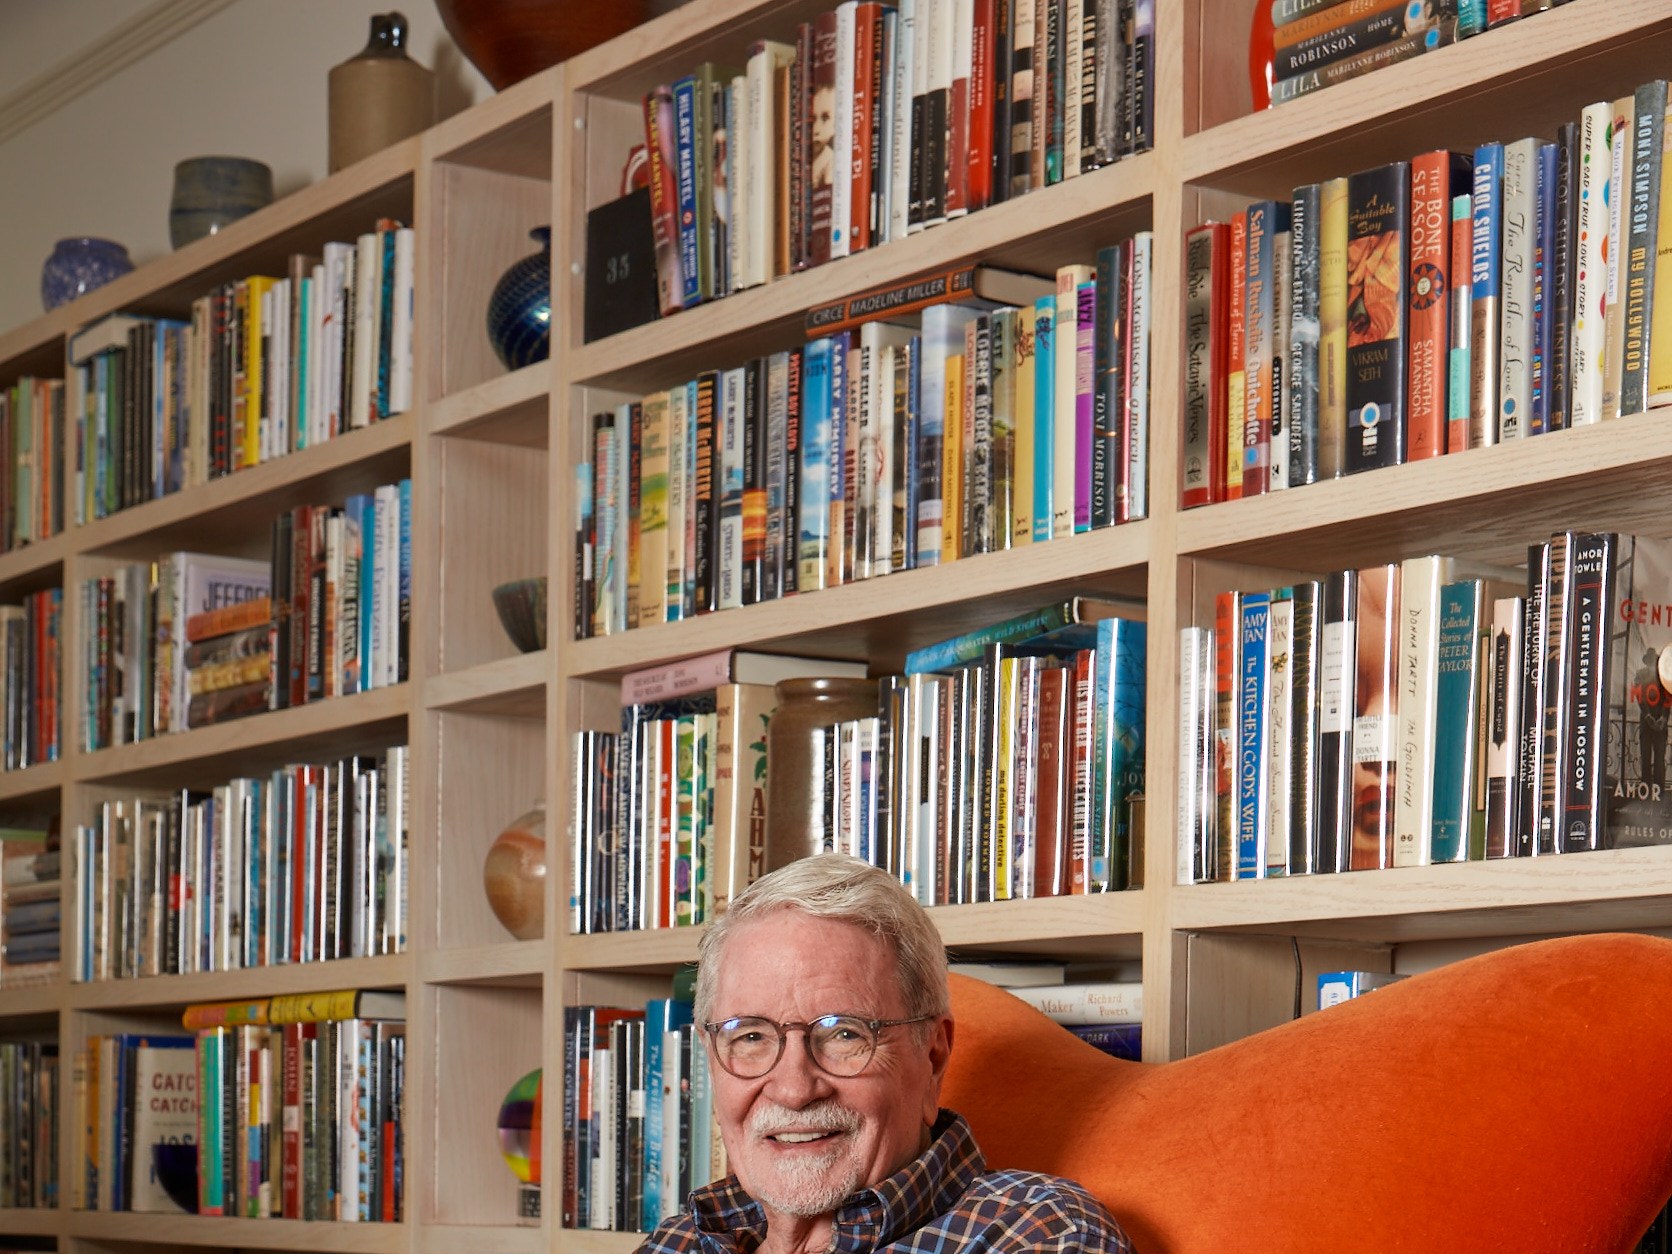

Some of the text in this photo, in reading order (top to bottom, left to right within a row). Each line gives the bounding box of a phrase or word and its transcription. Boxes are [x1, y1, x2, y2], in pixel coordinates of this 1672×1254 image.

[1367, 16, 1394, 34] HOME
[1280, 40, 1417, 100] LILA MARILYNNE ROBINSON
[1289, 34, 1358, 69] ROBINSON
[648, 99, 663, 152] HILARY
[1635, 114, 1653, 161] MONA
[651, 153, 667, 206] MANTEL
[1366, 193, 1378, 207] A
[1506, 151, 1516, 203] Shields
[1515, 151, 1526, 200] Carol
[1631, 163, 1651, 235] SIMPSON
[1350, 202, 1396, 224] Suitable
[1356, 220, 1382, 235] Boy
[1410, 169, 1428, 262] SEASON
[1425, 164, 1443, 257] THE BONE
[1471, 163, 1492, 284] CAROL SHIELDS
[1578, 114, 1592, 375] SUPER SAD TRUE LOVE STORY GARY
[1132, 250, 1145, 293] TONI
[1551, 146, 1570, 393] CAROL SHIELDS UNLESS
[812, 278, 945, 325] CIRCE MADELINE MILLER
[1503, 211, 1526, 396] The Republic of Love
[1626, 278, 1644, 372] HOLLYWOOD
[1130, 296, 1143, 388] MORRISON
[1187, 238, 1212, 444] Rushdie The Satanic Verses
[1245, 209, 1265, 447] Salman Rushdie Quichotte
[834, 343, 843, 400] LARRY
[966, 332, 976, 380] LORRIE
[976, 328, 991, 389] LORRIE
[1352, 347, 1389, 368] VIKRAM
[1358, 365, 1382, 384] SETH
[1411, 340, 1425, 419] SHANNON
[1421, 338, 1435, 418] SAMANTHA
[859, 345, 871, 431] SIN KILLER
[965, 385, 975, 438] MOORE
[975, 395, 992, 450] MOORE
[1128, 411, 1140, 463] mercy
[945, 449, 954, 476] DAVID
[1094, 393, 1107, 517] TONI MORRISON
[944, 478, 953, 519] MITCHELL
[1577, 548, 1603, 561] AMOR
[1245, 611, 1267, 628] AMY
[1407, 609, 1426, 650] DONNA
[1441, 615, 1471, 630] Collected
[1449, 602, 1462, 614] The
[1244, 627, 1265, 643] TAN
[1439, 631, 1461, 643] Stories
[1439, 644, 1469, 658] PETER
[1498, 644, 1507, 663] The
[1531, 583, 1543, 689] THE RETURN OF
[1271, 680, 1285, 705] The
[1407, 654, 1420, 699] TARTT
[1497, 664, 1506, 690] Darts
[1576, 596, 1591, 791] A GENTLEMAN IN MOSCOW
[1271, 707, 1284, 758] Hundred
[1496, 706, 1506, 734] Cupid
[1241, 655, 1258, 844] The KITCHEN GOD'S WIFE
[1527, 726, 1539, 790] MICHAEL
[1403, 742, 1420, 809] GOLDFINCH
[1613, 780, 1662, 802] AMOR
[982, 768, 994, 873] HOWARD NORMAN
[998, 786, 1009, 820] darling
[997, 823, 1008, 870] detective
[1624, 825, 1655, 838] RULES
[1041, 999, 1075, 1015] Maker
[1087, 992, 1129, 1018] Richard Powers
[563, 1031, 575, 1131] EDNA O'BRIEN
[649, 1069, 664, 1137] Invisible
[648, 1141, 661, 1190] Bridge
